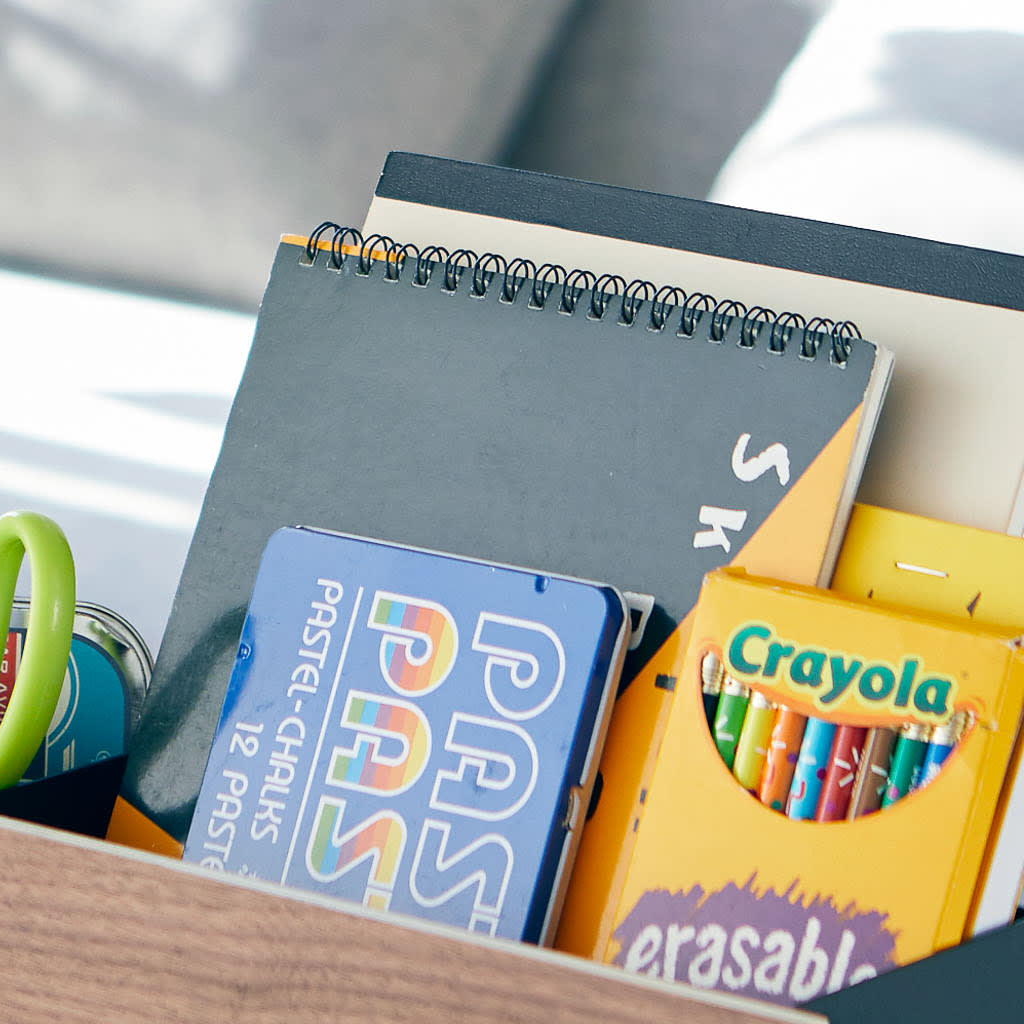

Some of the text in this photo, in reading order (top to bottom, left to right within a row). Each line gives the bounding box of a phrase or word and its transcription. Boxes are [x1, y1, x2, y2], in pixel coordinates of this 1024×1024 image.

[229, 721, 264, 758] 12
[305, 590, 459, 914] PAS
[407, 611, 566, 938] PAS
[729, 624, 954, 717] Crayola
